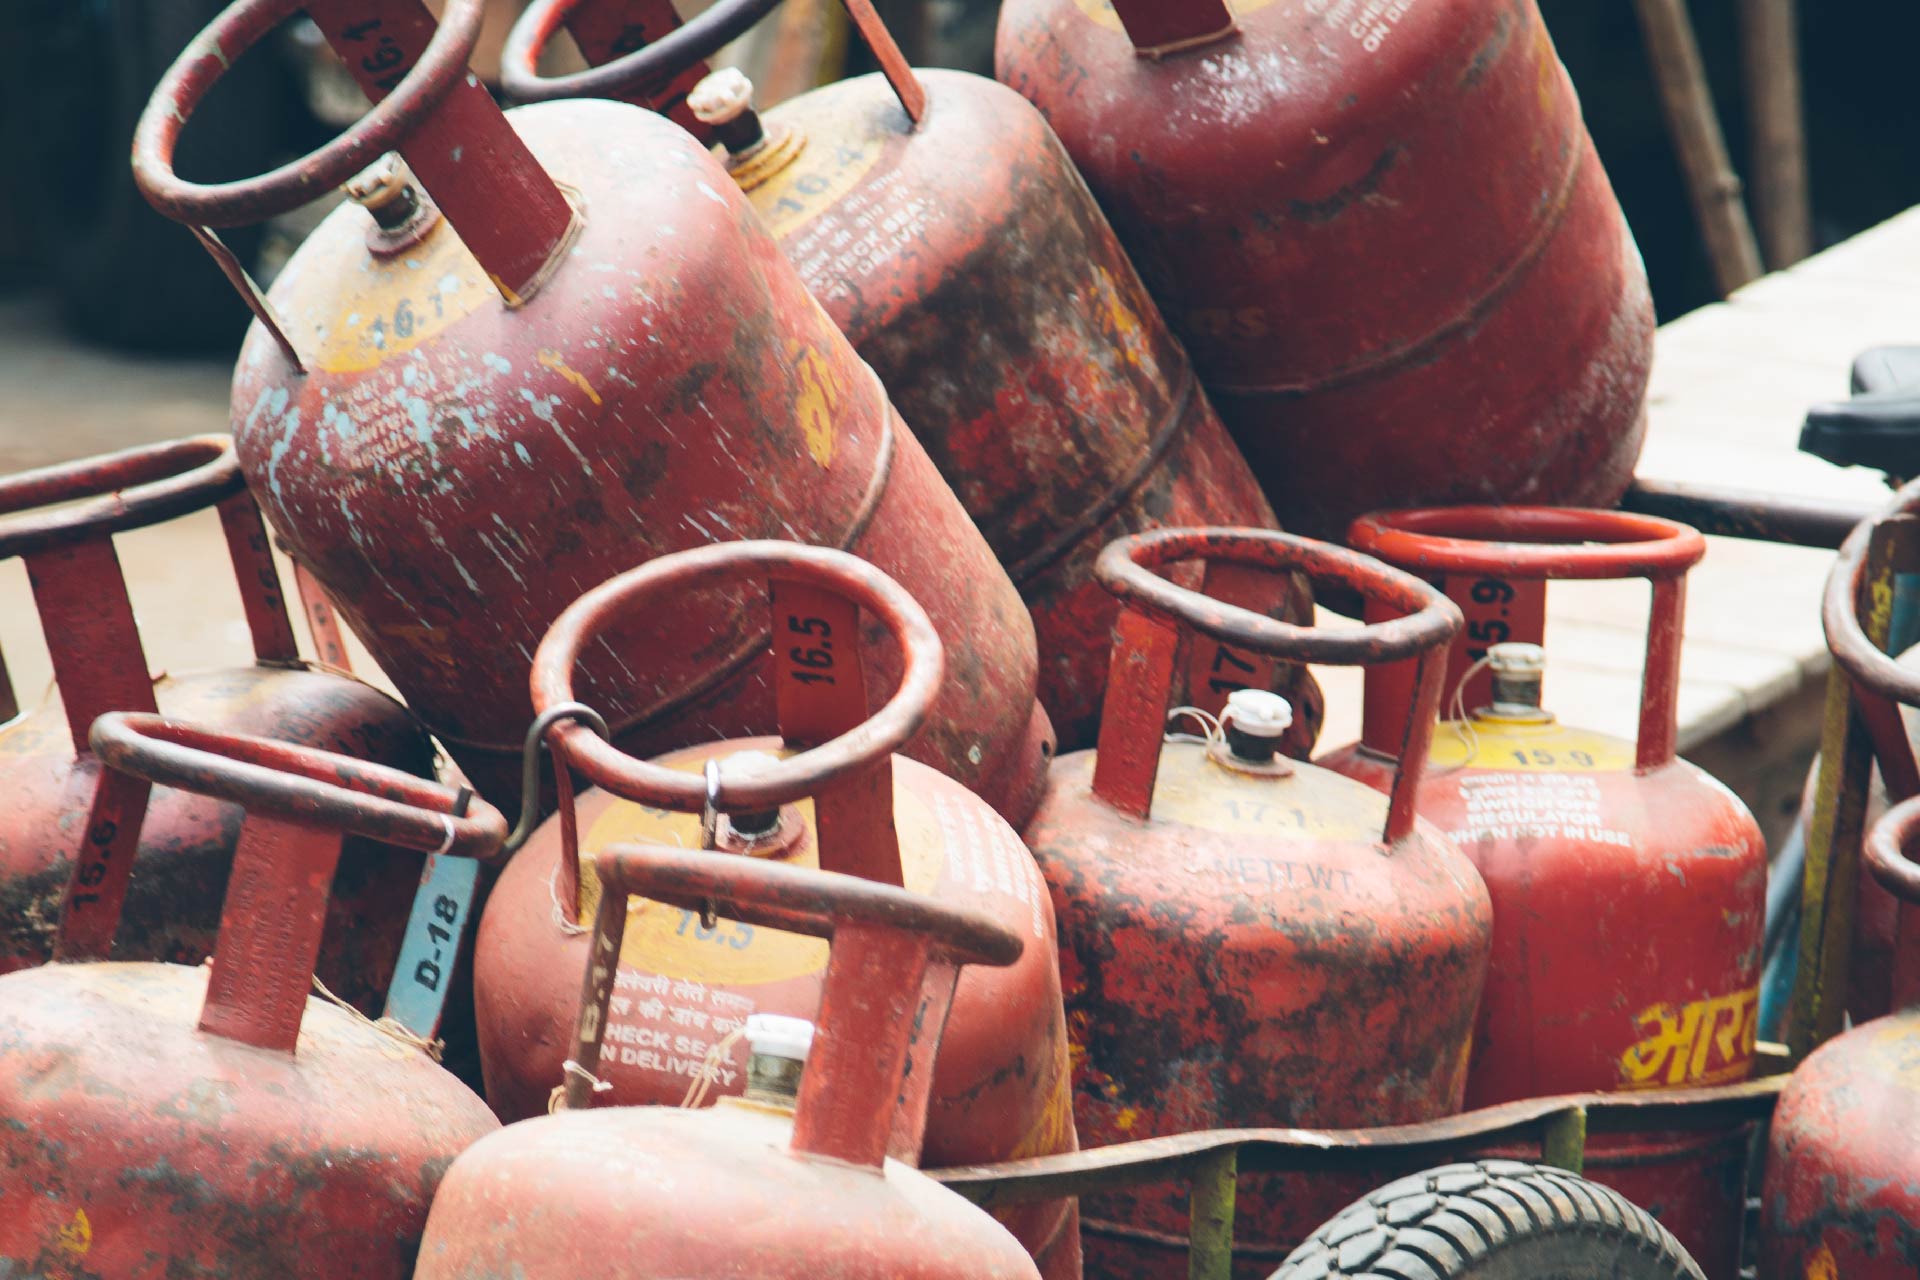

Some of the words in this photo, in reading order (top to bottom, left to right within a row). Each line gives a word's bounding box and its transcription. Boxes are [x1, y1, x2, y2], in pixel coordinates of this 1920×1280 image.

[787, 614, 836, 687] 16.5
[1466, 811, 1602, 827] REGULATOR
[1563, 824, 1586, 841] IN
[1589, 826, 1631, 848] USE
[73, 820, 117, 912] 15.6
[414, 894, 458, 993] D-18
[599, 1042, 617, 1063] N
[620, 1046, 738, 1088] DELIVERY
[604, 1022, 672, 1052] HECK
[674, 1034, 738, 1066] SEAL
